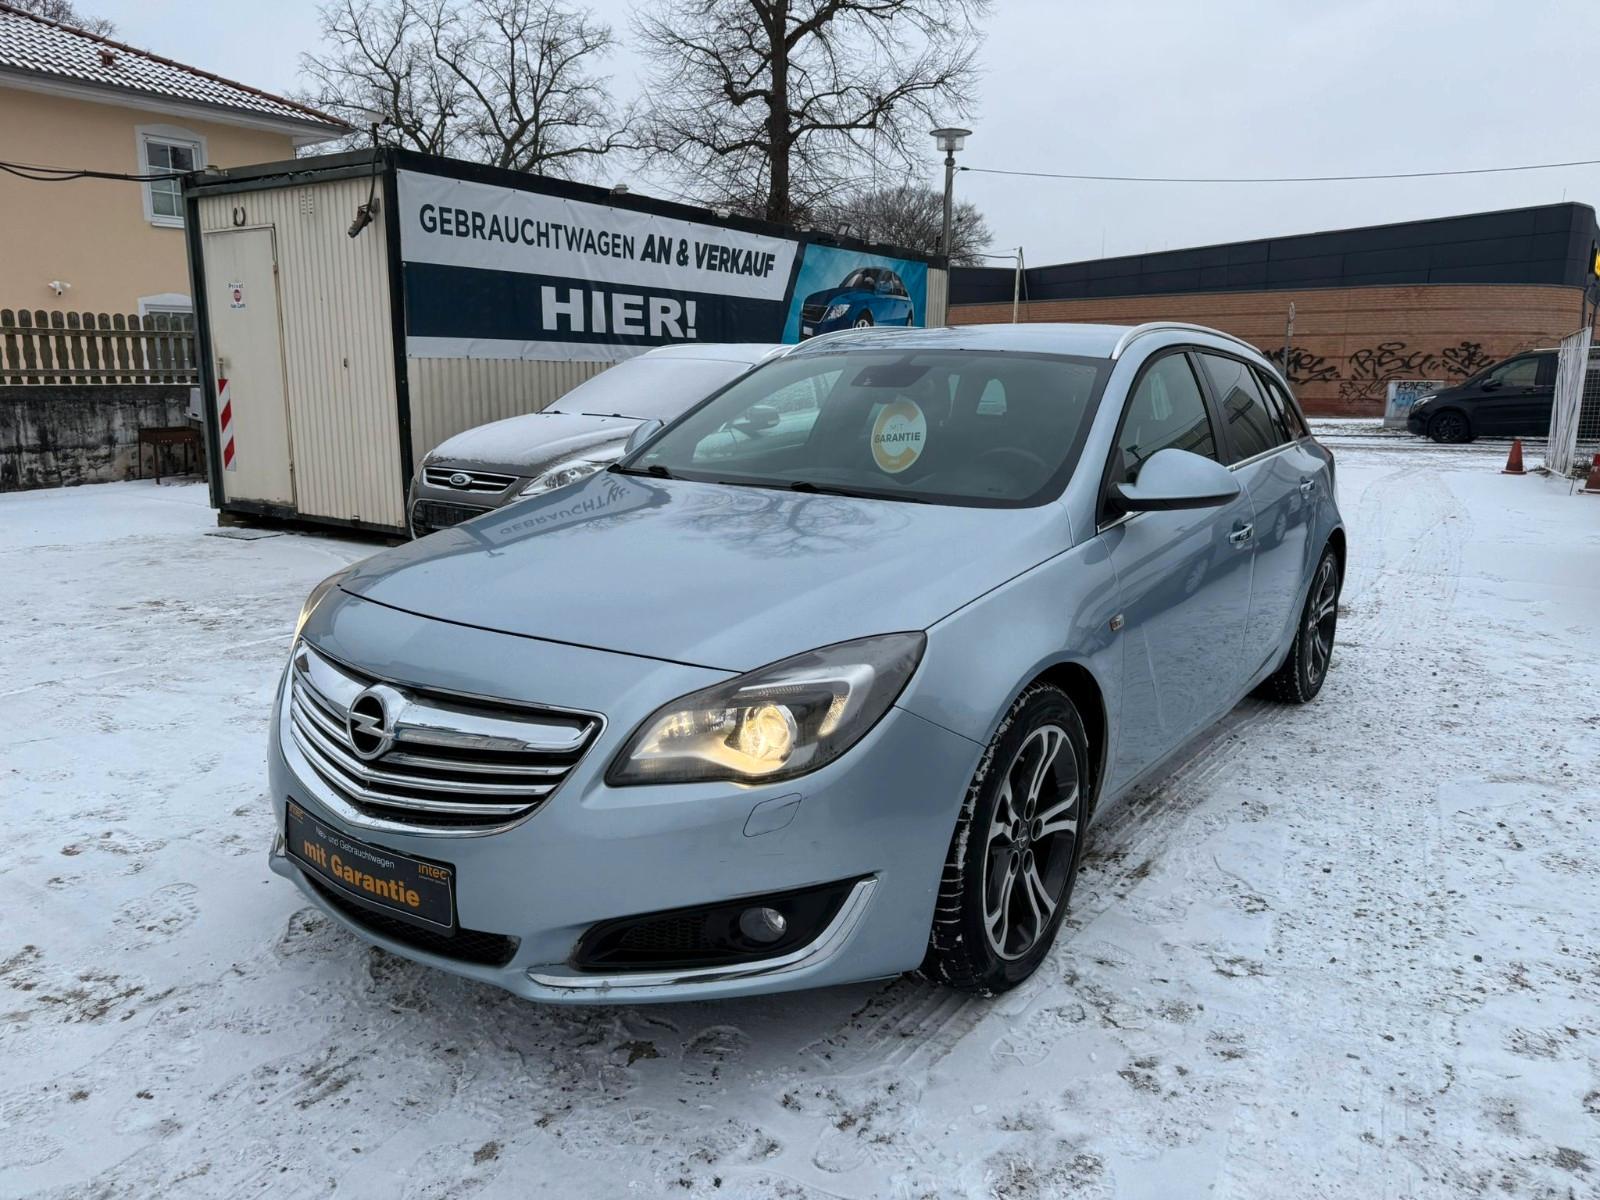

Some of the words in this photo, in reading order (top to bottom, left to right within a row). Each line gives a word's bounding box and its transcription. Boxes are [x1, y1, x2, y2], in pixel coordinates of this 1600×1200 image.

[420, 203, 634, 259] GEBRAUCHTWAGEN
[640, 234, 673, 264] AN
[676, 238, 690, 266] &
[695, 241, 775, 278] VERKAUF
[541, 285, 697, 339] HIER!
[874, 431, 921, 443] GARANTIE
[304, 840, 327, 868] mit
[330, 854, 421, 907] Garantie
[339, 839, 395, 869] Gebrauchtwagen
